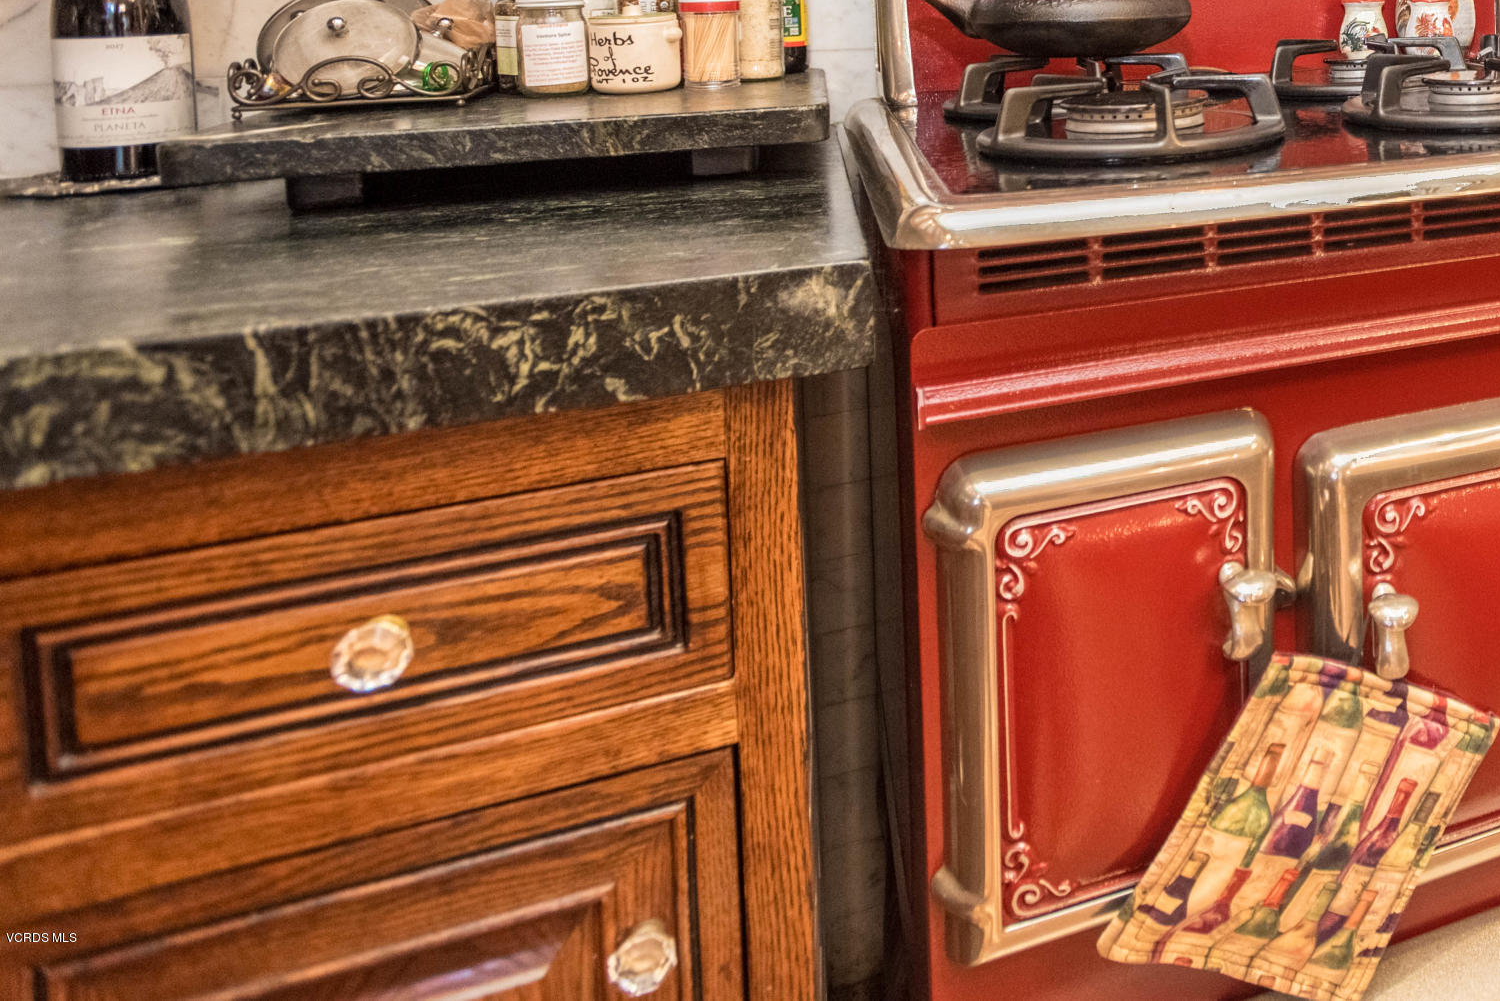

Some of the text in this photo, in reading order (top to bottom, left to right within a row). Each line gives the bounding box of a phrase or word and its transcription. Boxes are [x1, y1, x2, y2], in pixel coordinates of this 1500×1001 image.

[591, 31, 634, 47] Herbs
[604, 46, 616, 69] of
[101, 106, 136, 117] ETNA
[93, 121, 147, 132] PLANETA
